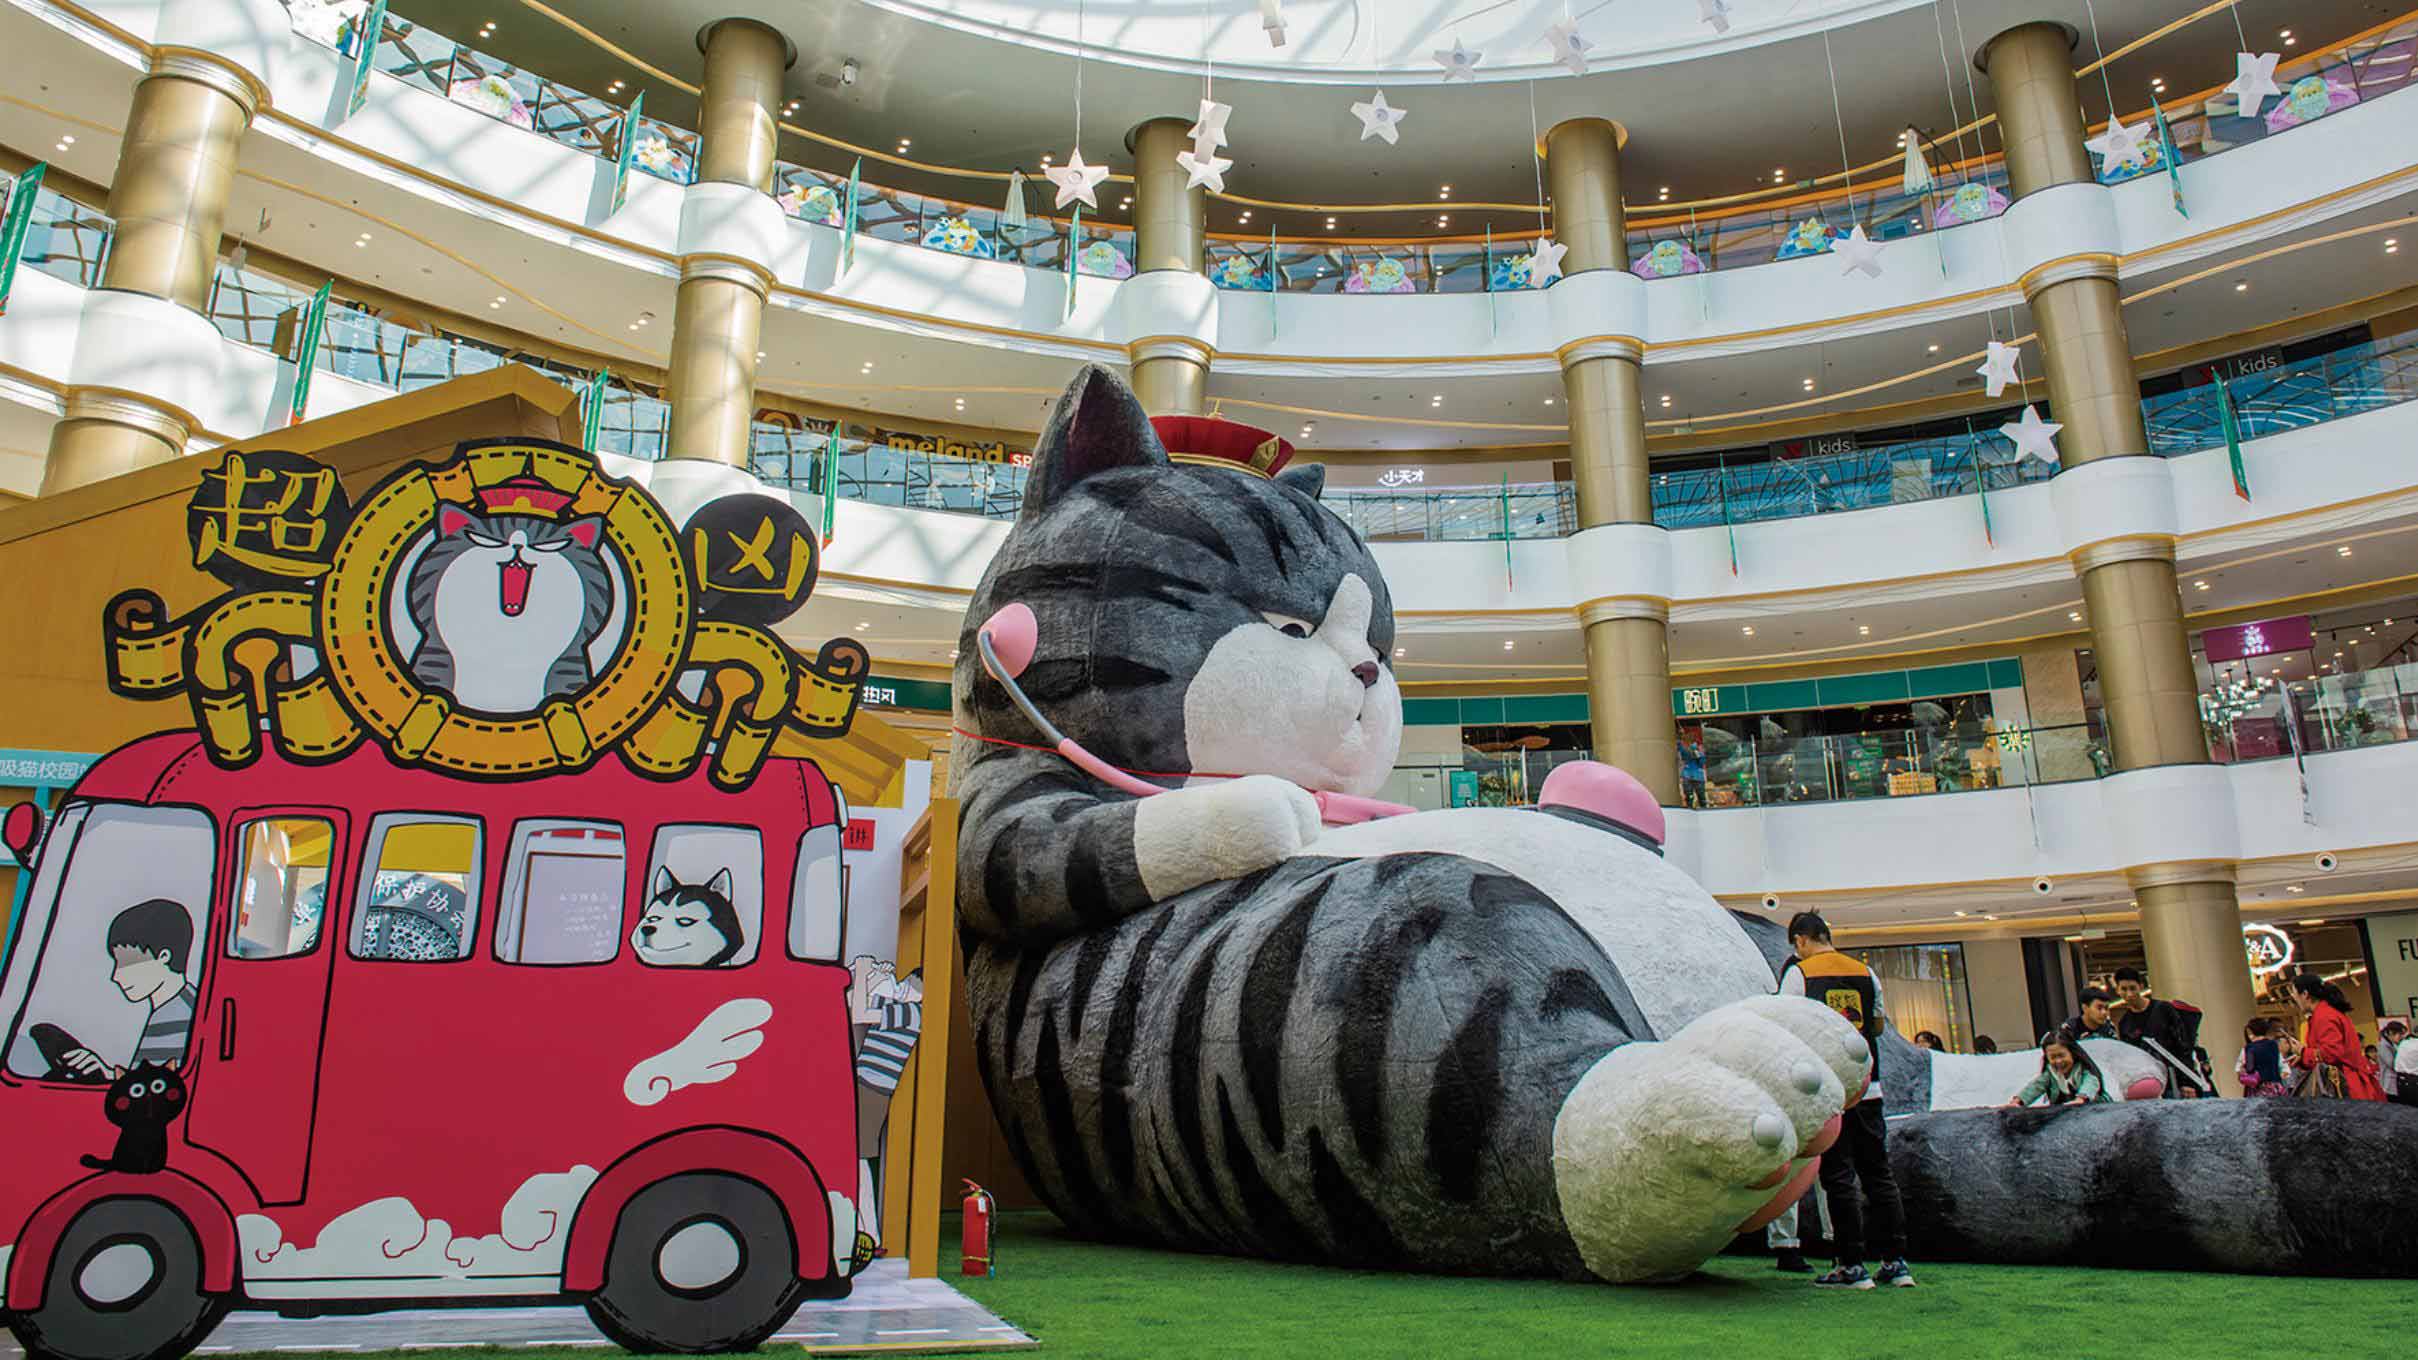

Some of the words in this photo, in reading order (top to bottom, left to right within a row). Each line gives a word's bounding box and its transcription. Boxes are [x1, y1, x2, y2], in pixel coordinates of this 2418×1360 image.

[2238, 353, 2278, 375] kids
[888, 435, 1005, 464] meland
[1818, 438, 1851, 456] kids
[192, 454, 336, 577] 超
[694, 515, 811, 601] 凶
